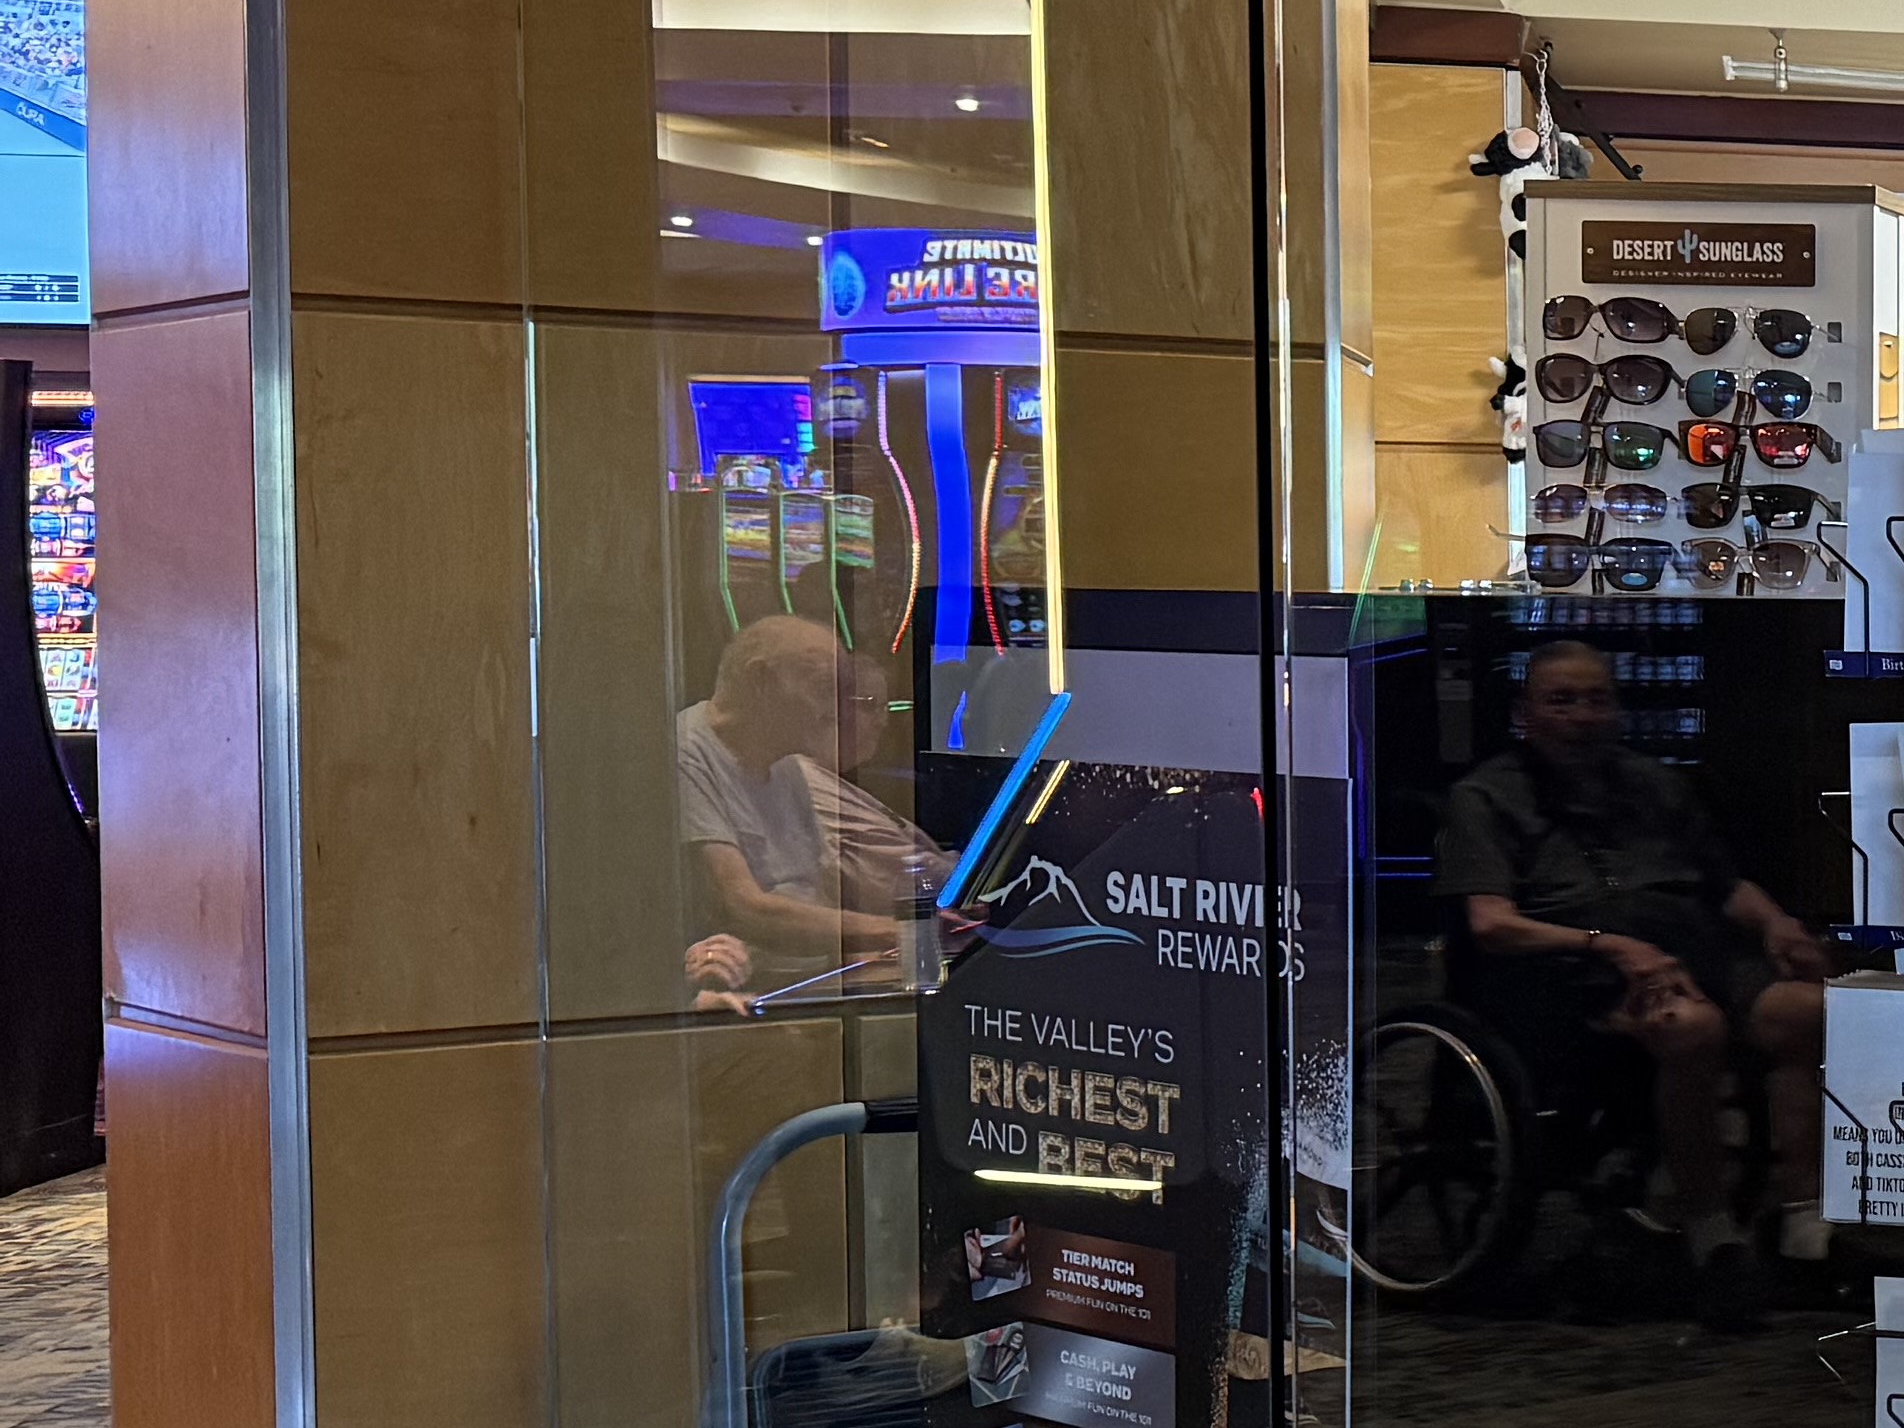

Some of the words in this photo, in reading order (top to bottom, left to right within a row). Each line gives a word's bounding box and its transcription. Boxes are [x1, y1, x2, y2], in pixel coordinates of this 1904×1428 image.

[1612, 240, 1674, 261] DESERT
[1699, 241, 1784, 263] SUNGLASS
[1106, 871, 1187, 919] SALT
[964, 1004, 1023, 1042] THE
[1030, 1013, 1175, 1064] VALLEY'S
[969, 1053, 1181, 1135] RICHEST
[1872, 1128, 1893, 1144] YOU
[967, 1118, 1027, 1156] AND
[1038, 1130, 1177, 1205] BEST
[1846, 1151, 1873, 1168] BOH
[1061, 1249, 1089, 1267] TIER
[1091, 1255, 1135, 1276] MATCH
[1052, 1267, 1100, 1289] STATUS
[1100, 1278, 1144, 1299] JUMPS
[1086, 1297, 1104, 1310] FUN
[1105, 1301, 1119, 1314] ON
[1119, 1303, 1137, 1318] THE
[1060, 1350, 1100, 1373] CASH,
[1102, 1360, 1137, 1380] PLAY
[1076, 1375, 1132, 1401] BEYOND
